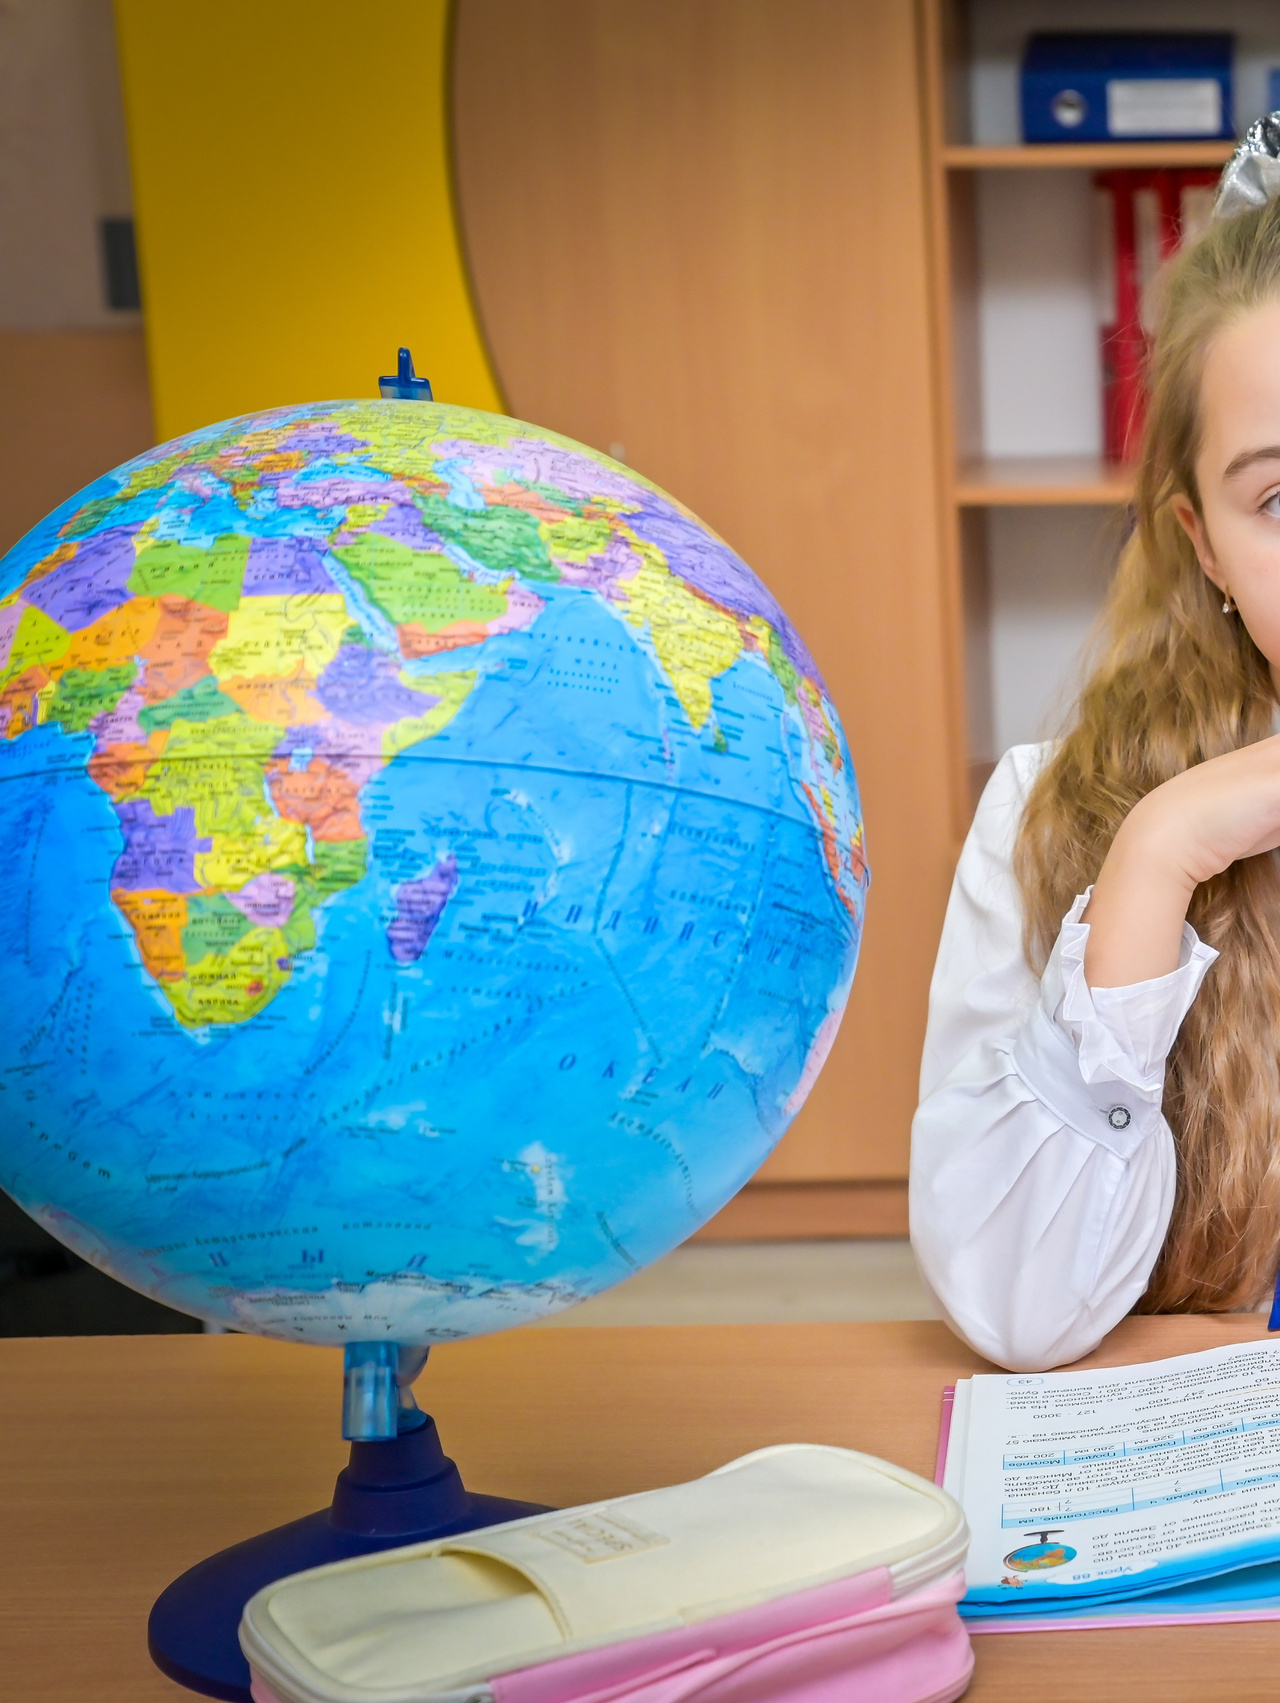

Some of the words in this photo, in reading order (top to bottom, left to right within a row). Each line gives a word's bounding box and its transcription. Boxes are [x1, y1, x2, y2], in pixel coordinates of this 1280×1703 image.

[1207, 1383, 1262, 1398] значения
[1153, 1434, 1174, 1442] 320
[1190, 1428, 1238, 1440] Витебск
[1133, 1441, 1176, 1452] Гомель
[1074, 1452, 1116, 1461] Гродно
[1008, 1459, 1060, 1468] Могилёв
[1236, 1477, 1262, 1486] км/ч
[1241, 1483, 1276, 1494] реши
[1163, 1489, 1207, 1501] Время,
[1229, 1523, 1272, 1535] Земли
[1186, 1532, 1225, 1545] равна
[1138, 1547, 1162, 1555] 000
[1092, 1556, 1114, 1564] (по
[1072, 1573, 1091, 1581] 88
[1096, 1566, 1132, 1577] Урок
